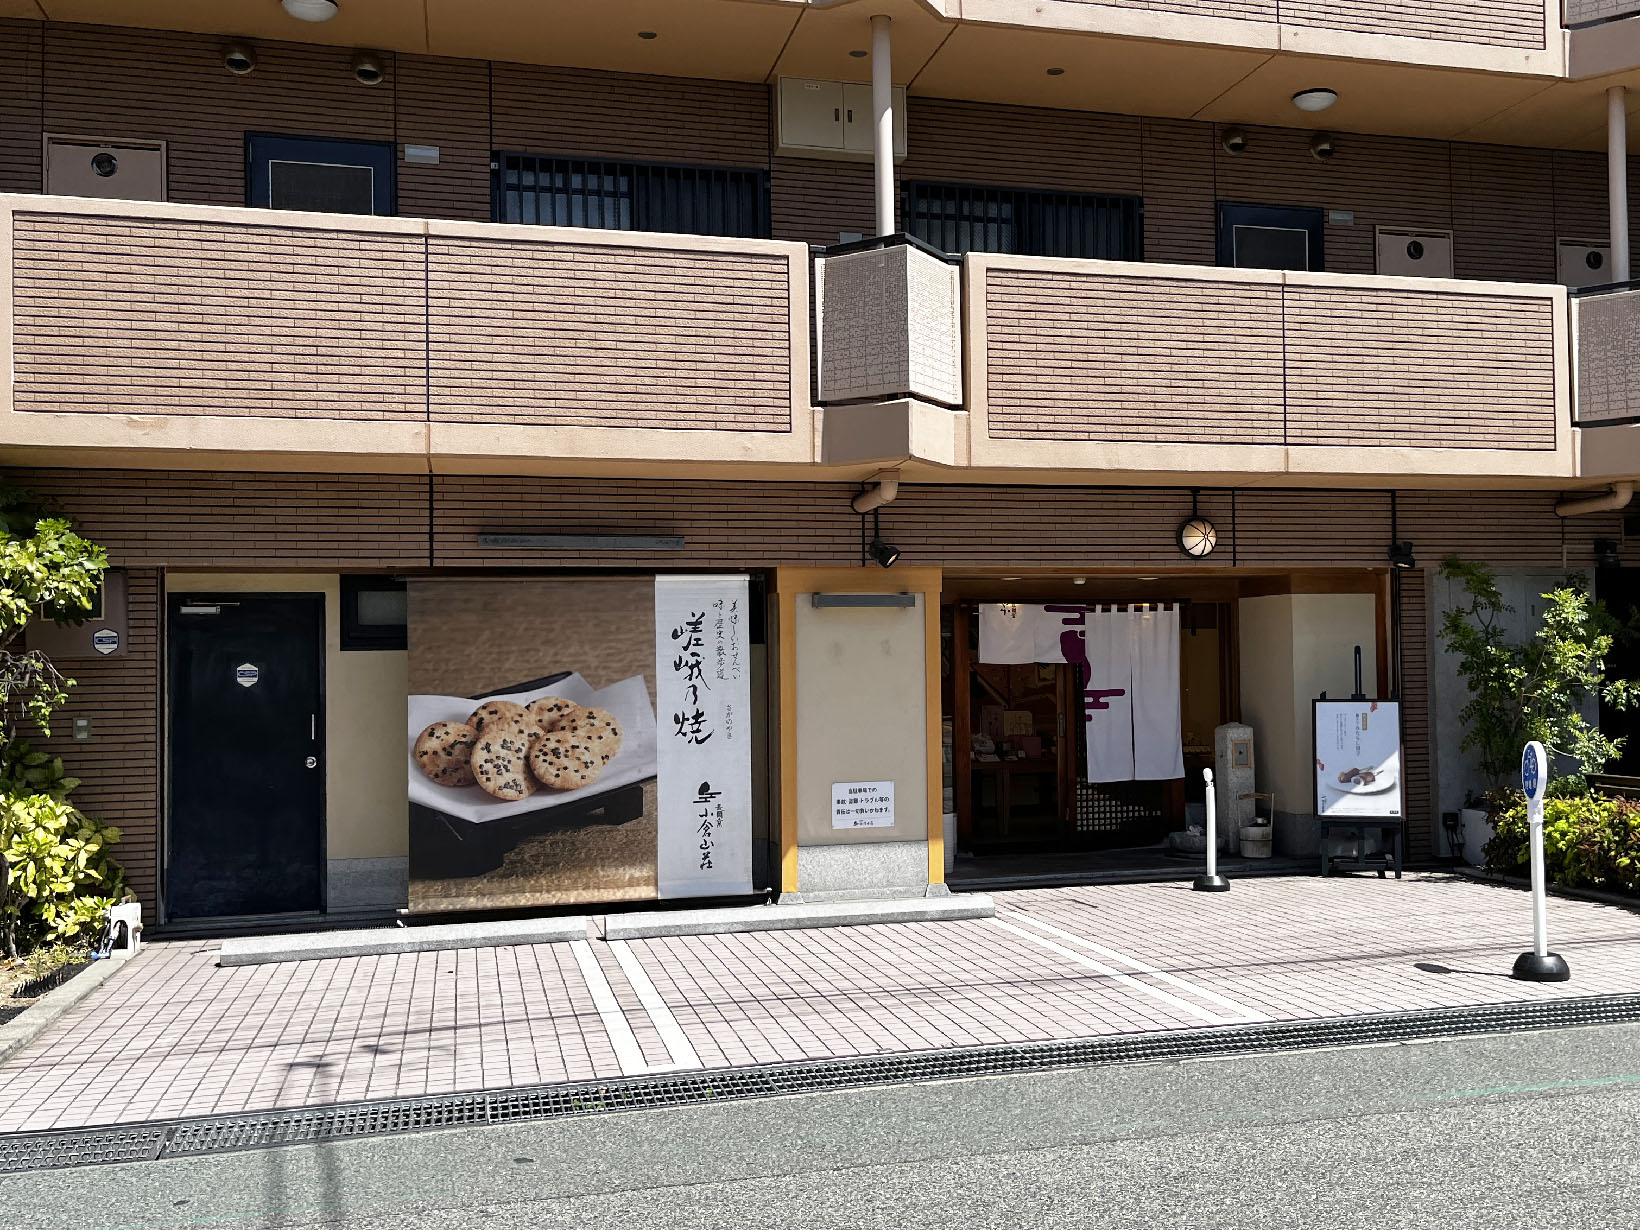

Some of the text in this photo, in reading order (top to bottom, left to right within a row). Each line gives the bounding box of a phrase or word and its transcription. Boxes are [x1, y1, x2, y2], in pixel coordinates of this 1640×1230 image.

[671, 611, 714, 745] 嵯峨乃焼
[725, 704, 734, 740] さがのやき
[697, 808, 714, 871] 小倉山荘
